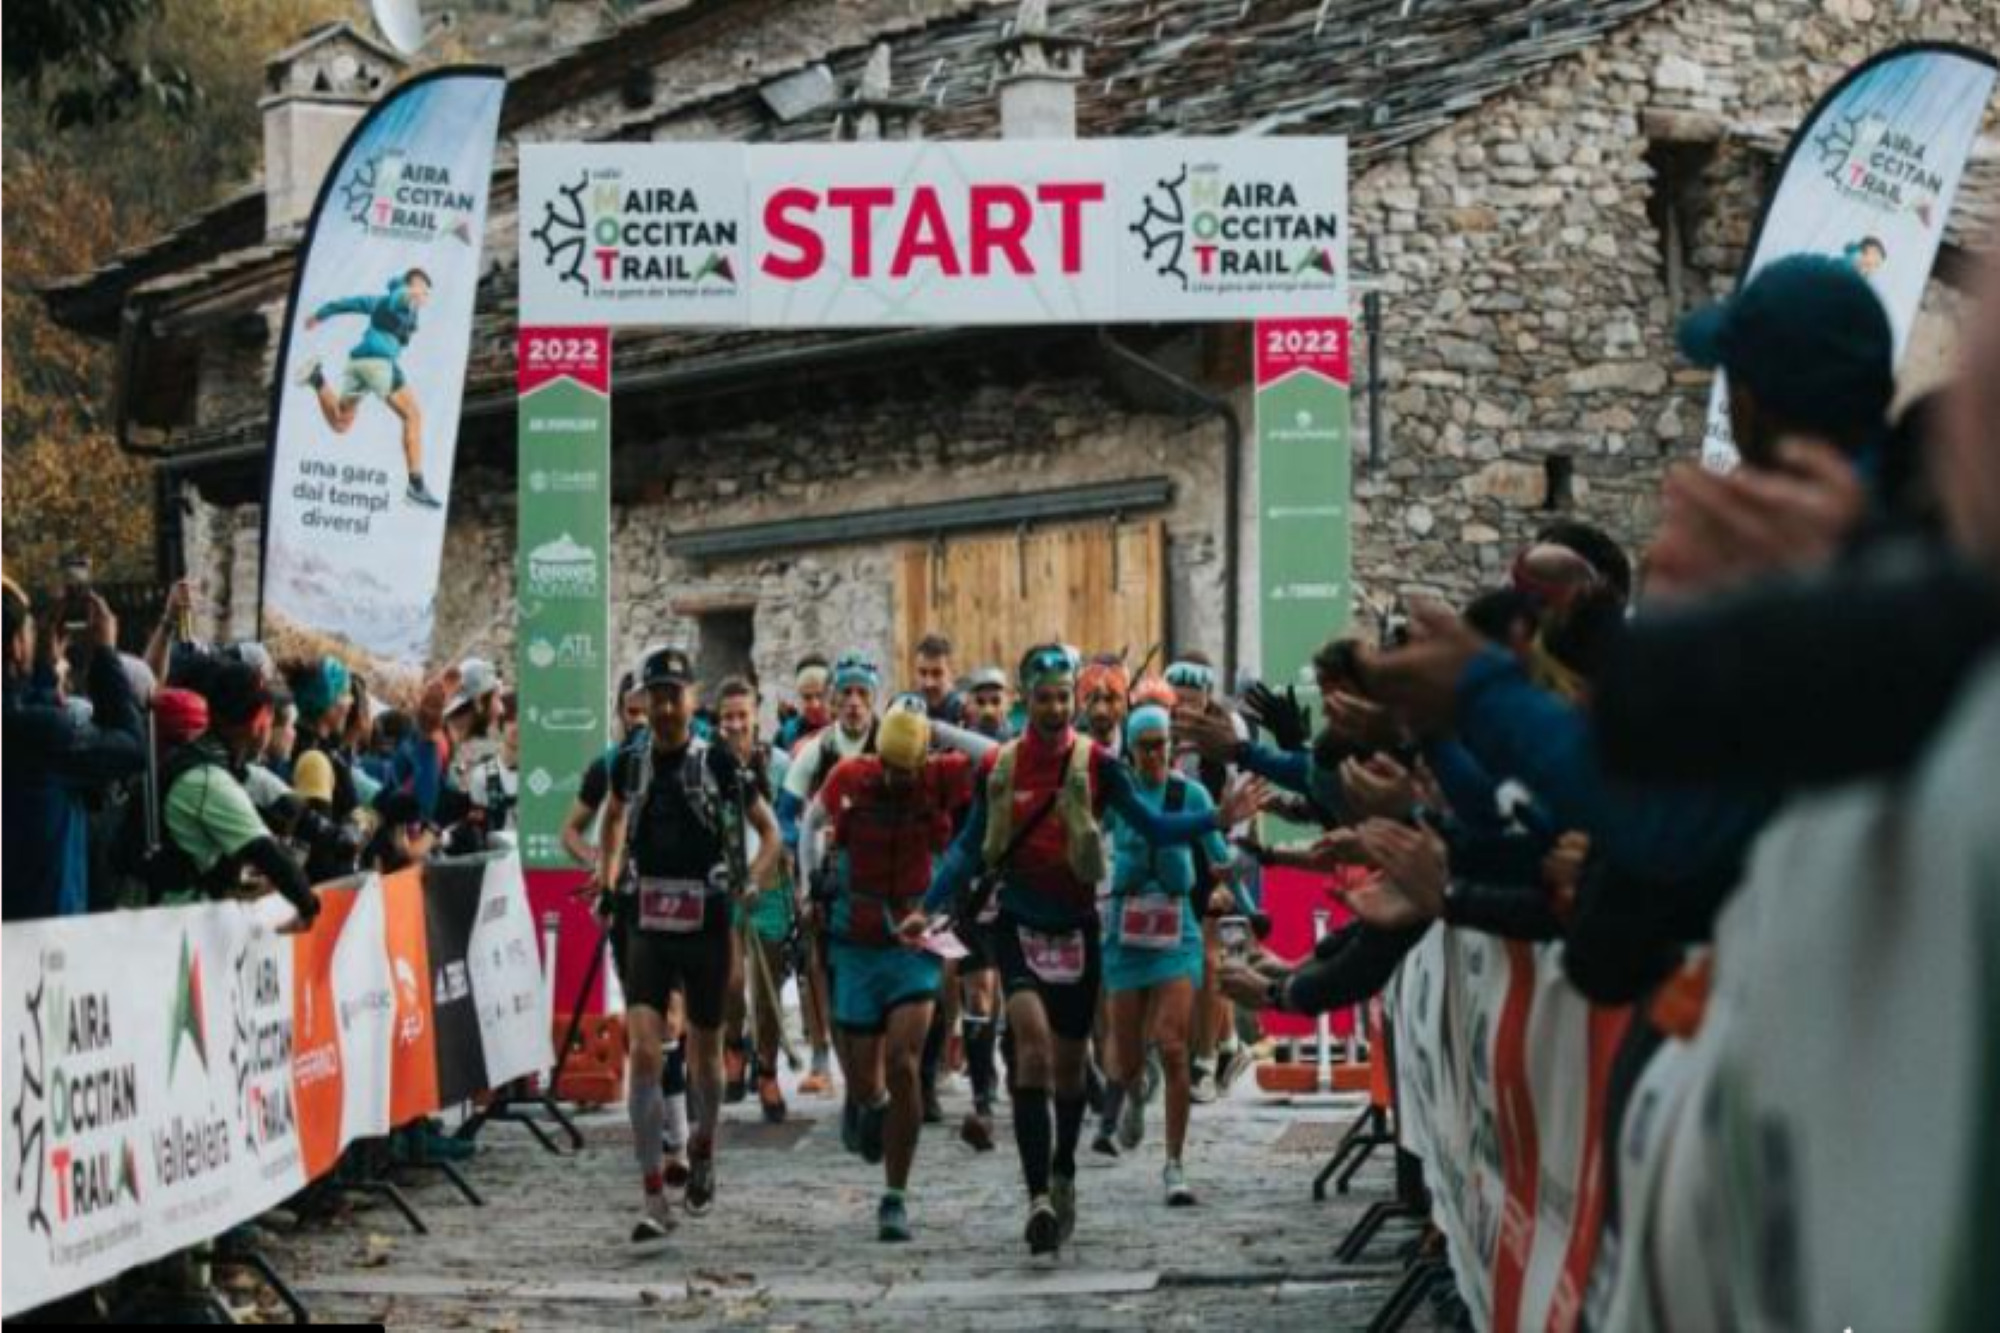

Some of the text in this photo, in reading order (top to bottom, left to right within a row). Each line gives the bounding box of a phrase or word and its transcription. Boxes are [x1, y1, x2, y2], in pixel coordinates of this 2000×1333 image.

[373, 198, 438, 233] TRAIL
[1192, 211, 1337, 241] OCCITAN
[595, 216, 738, 247] OCCITAN
[761, 182, 1105, 281] START
[593, 248, 692, 281] TRAIL
[1192, 245, 1291, 276] TRAIL
[528, 337, 600, 361] 2022
[1267, 328, 1340, 353] 2022
[298, 458, 389, 486] una gara
[292, 479, 391, 515] dai tempi
[301, 505, 371, 535] diversi
[51, 1063, 138, 1138] OCCITAN
[51, 1146, 115, 1223] TRAIL
